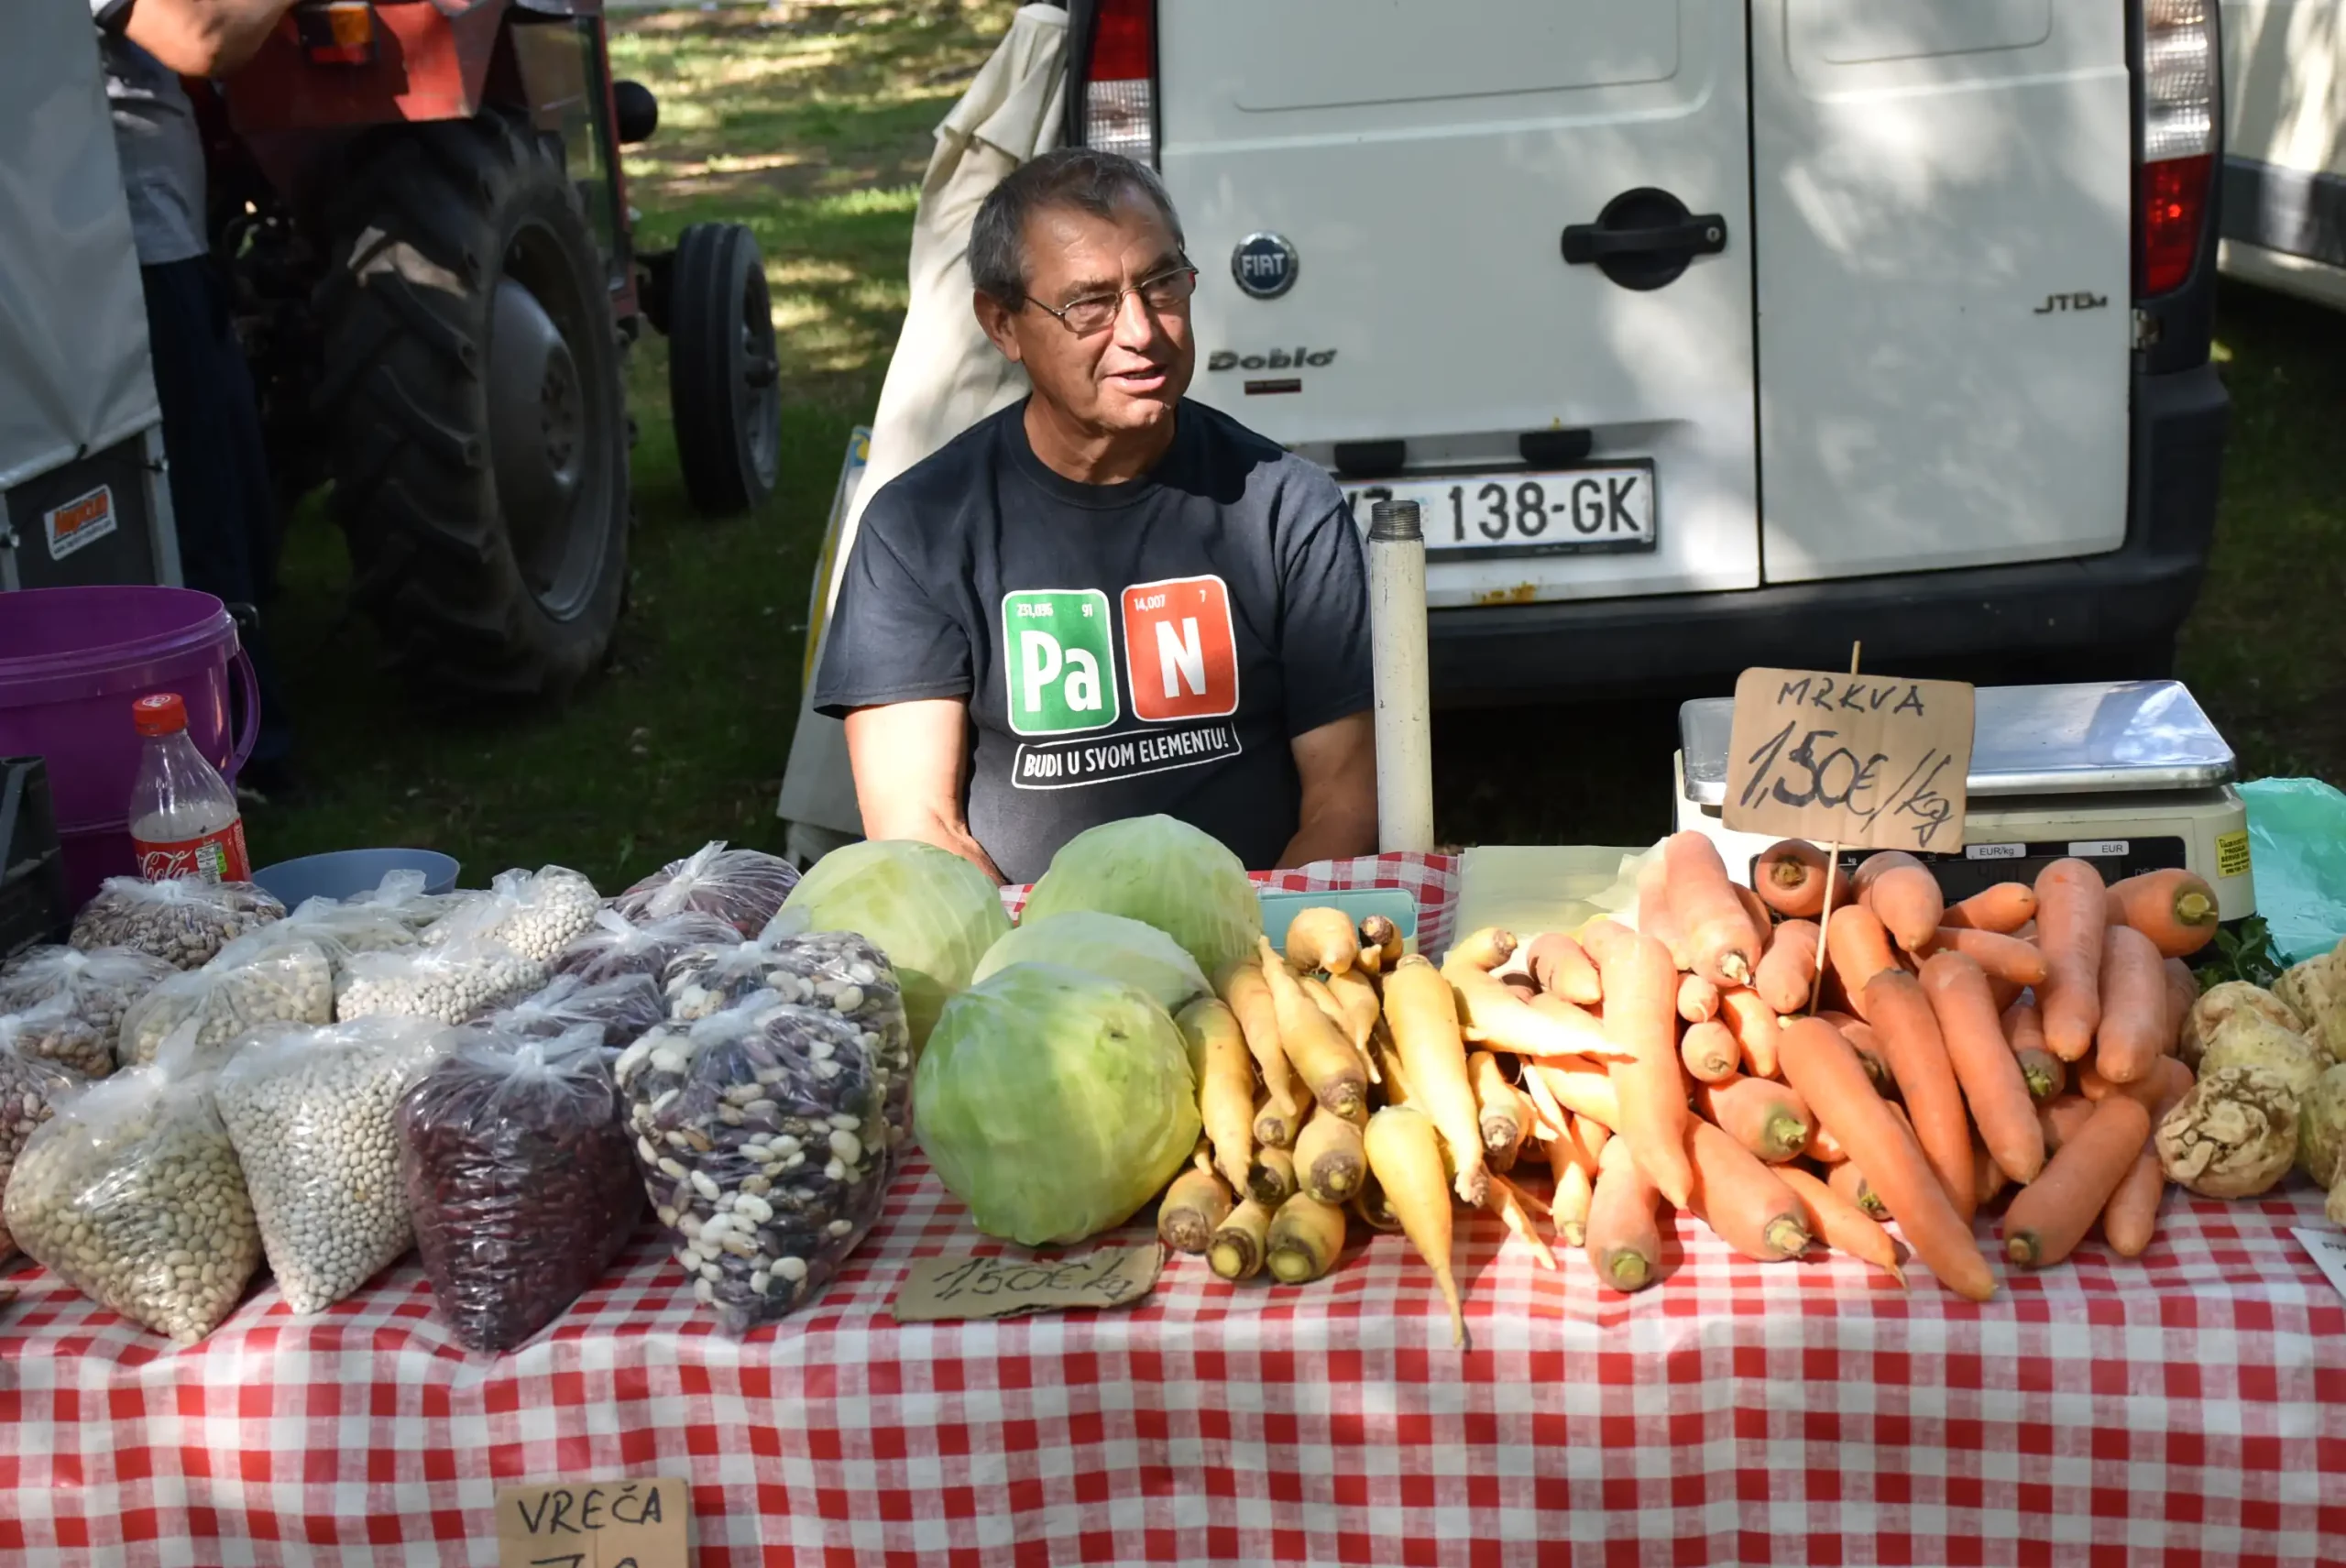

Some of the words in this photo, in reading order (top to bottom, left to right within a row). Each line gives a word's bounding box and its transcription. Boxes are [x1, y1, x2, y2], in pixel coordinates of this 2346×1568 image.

[1242, 253, 1285, 277] FIAT
[1449, 477, 1639, 542] 138-GK
[1081, 602, 1093, 618] 91
[1134, 594, 1166, 611] 14,007
[1200, 590, 1206, 603] 7
[1020, 630, 1102, 713] Pa
[1155, 617, 1207, 699] N
[1777, 677, 1924, 717] MRKVA
[1023, 753, 1062, 778] BUDI
[1067, 751, 1080, 775] U
[1085, 742, 1135, 773] SVOM
[1139, 727, 1230, 762] ELEMENTU!
[143, 850, 192, 882] Cola
[1979, 846, 2015, 857] EUR/kg
[2101, 843, 2123, 854] EUR
[518, 1485, 662, 1535] VREČA
